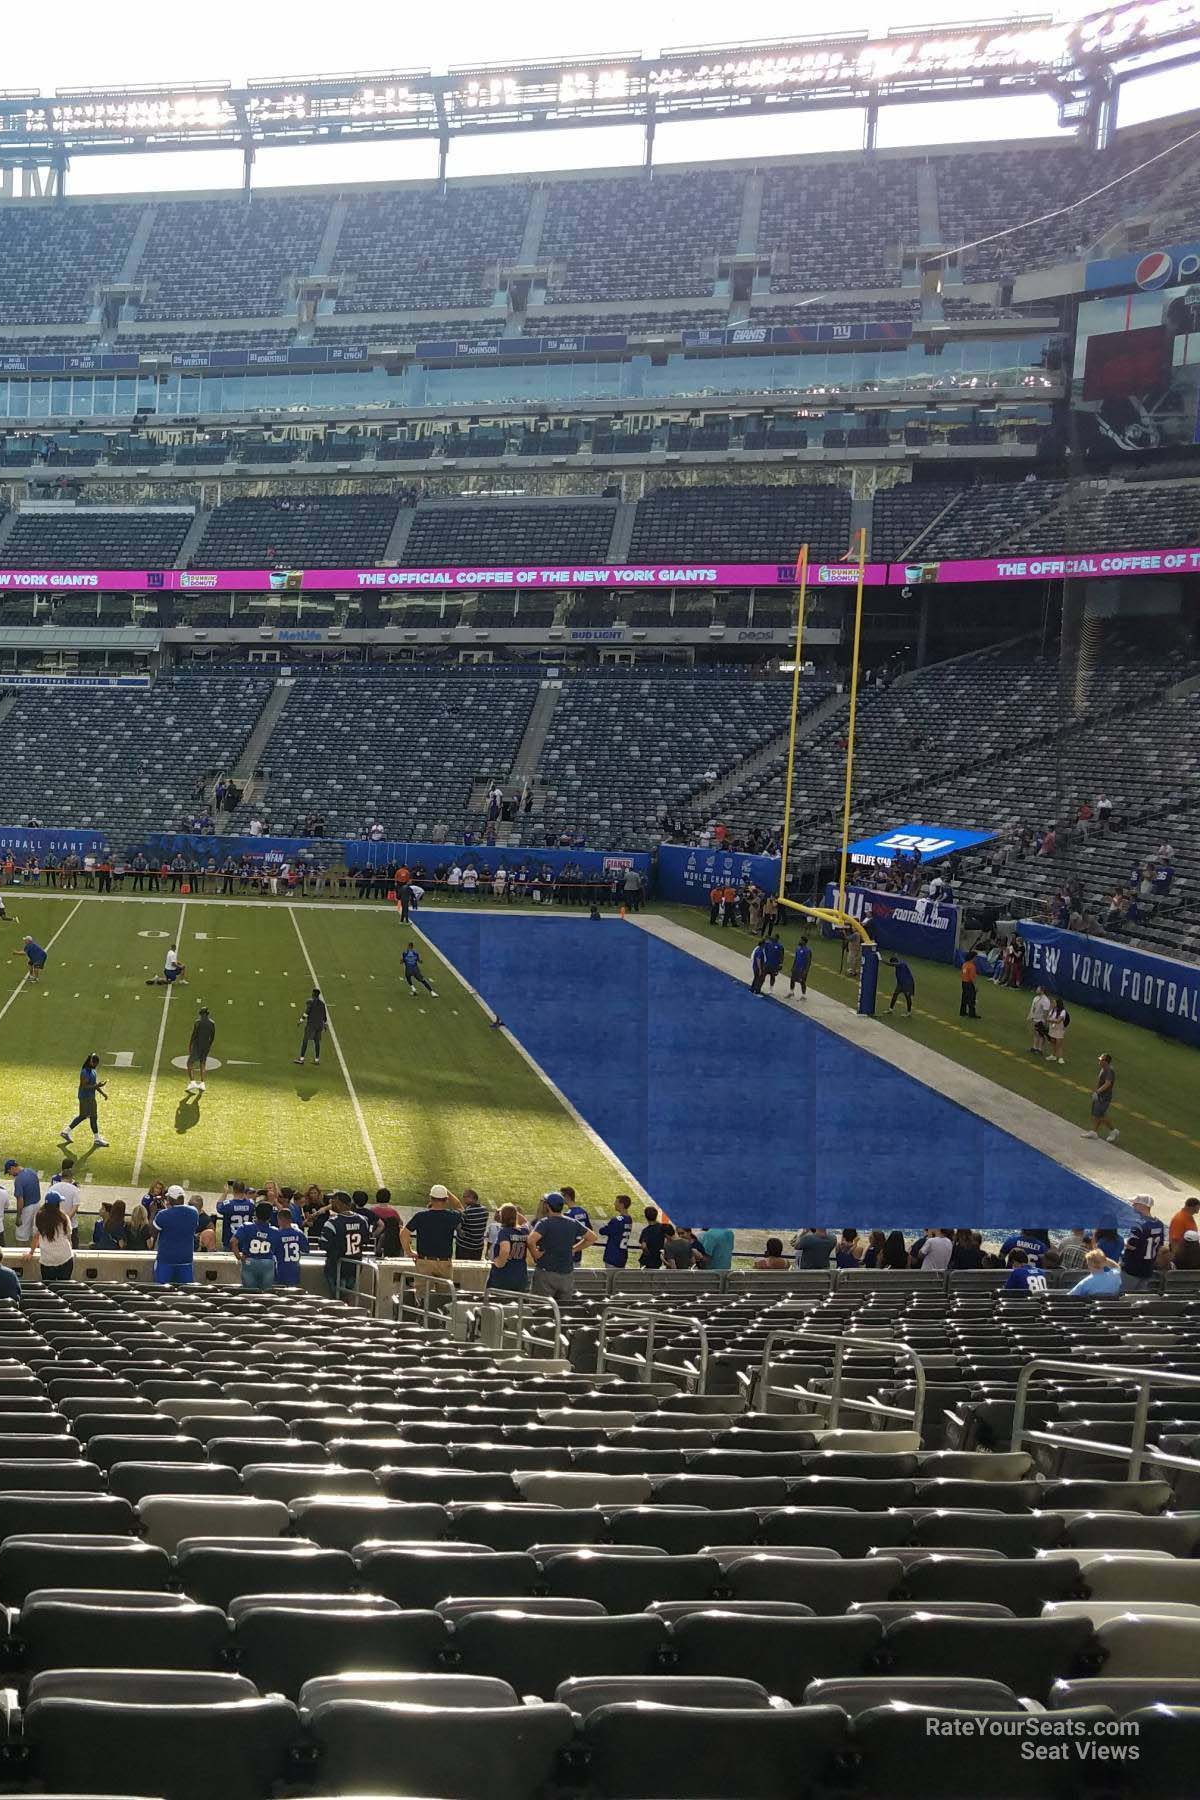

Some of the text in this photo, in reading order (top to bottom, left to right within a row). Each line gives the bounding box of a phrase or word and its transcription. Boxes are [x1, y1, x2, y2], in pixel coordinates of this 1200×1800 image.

[733, 328, 767, 341] GIANTS
[467, 345, 497, 355] JOHNSON
[997, 563, 1026, 575] THE
[1030, 560, 1097, 574] OFFICIAL
[1101, 556, 1161, 570] COFFEE
[1164, 555, 1186, 567] OF
[13, 575, 48, 585] YORK
[50, 575, 98, 585] GIANTS
[358, 570, 716, 584] THE OFFICIAL COFFEE OF THE NEW YORK GIANTS
[278, 630, 321, 641] MetLife
[572, 631, 622, 639] BUD LIGHT
[738, 630, 774, 642] pepsi
[50, 840, 83, 851] GIANT
[264, 852, 284, 863] WFAN
[851, 853, 875, 866] METLIFE
[683, 872, 707, 882] WORLD
[1024, 941, 1061, 975] NEW
[1071, 952, 1114, 993] YORK
[104, 1051, 222, 1071] 10
[345, 1233, 362, 1256] 12
[1016, 1240, 1041, 1251] BARKLEY
[283, 1242, 300, 1262] 13
[1026, 1275, 1048, 1293] 80
